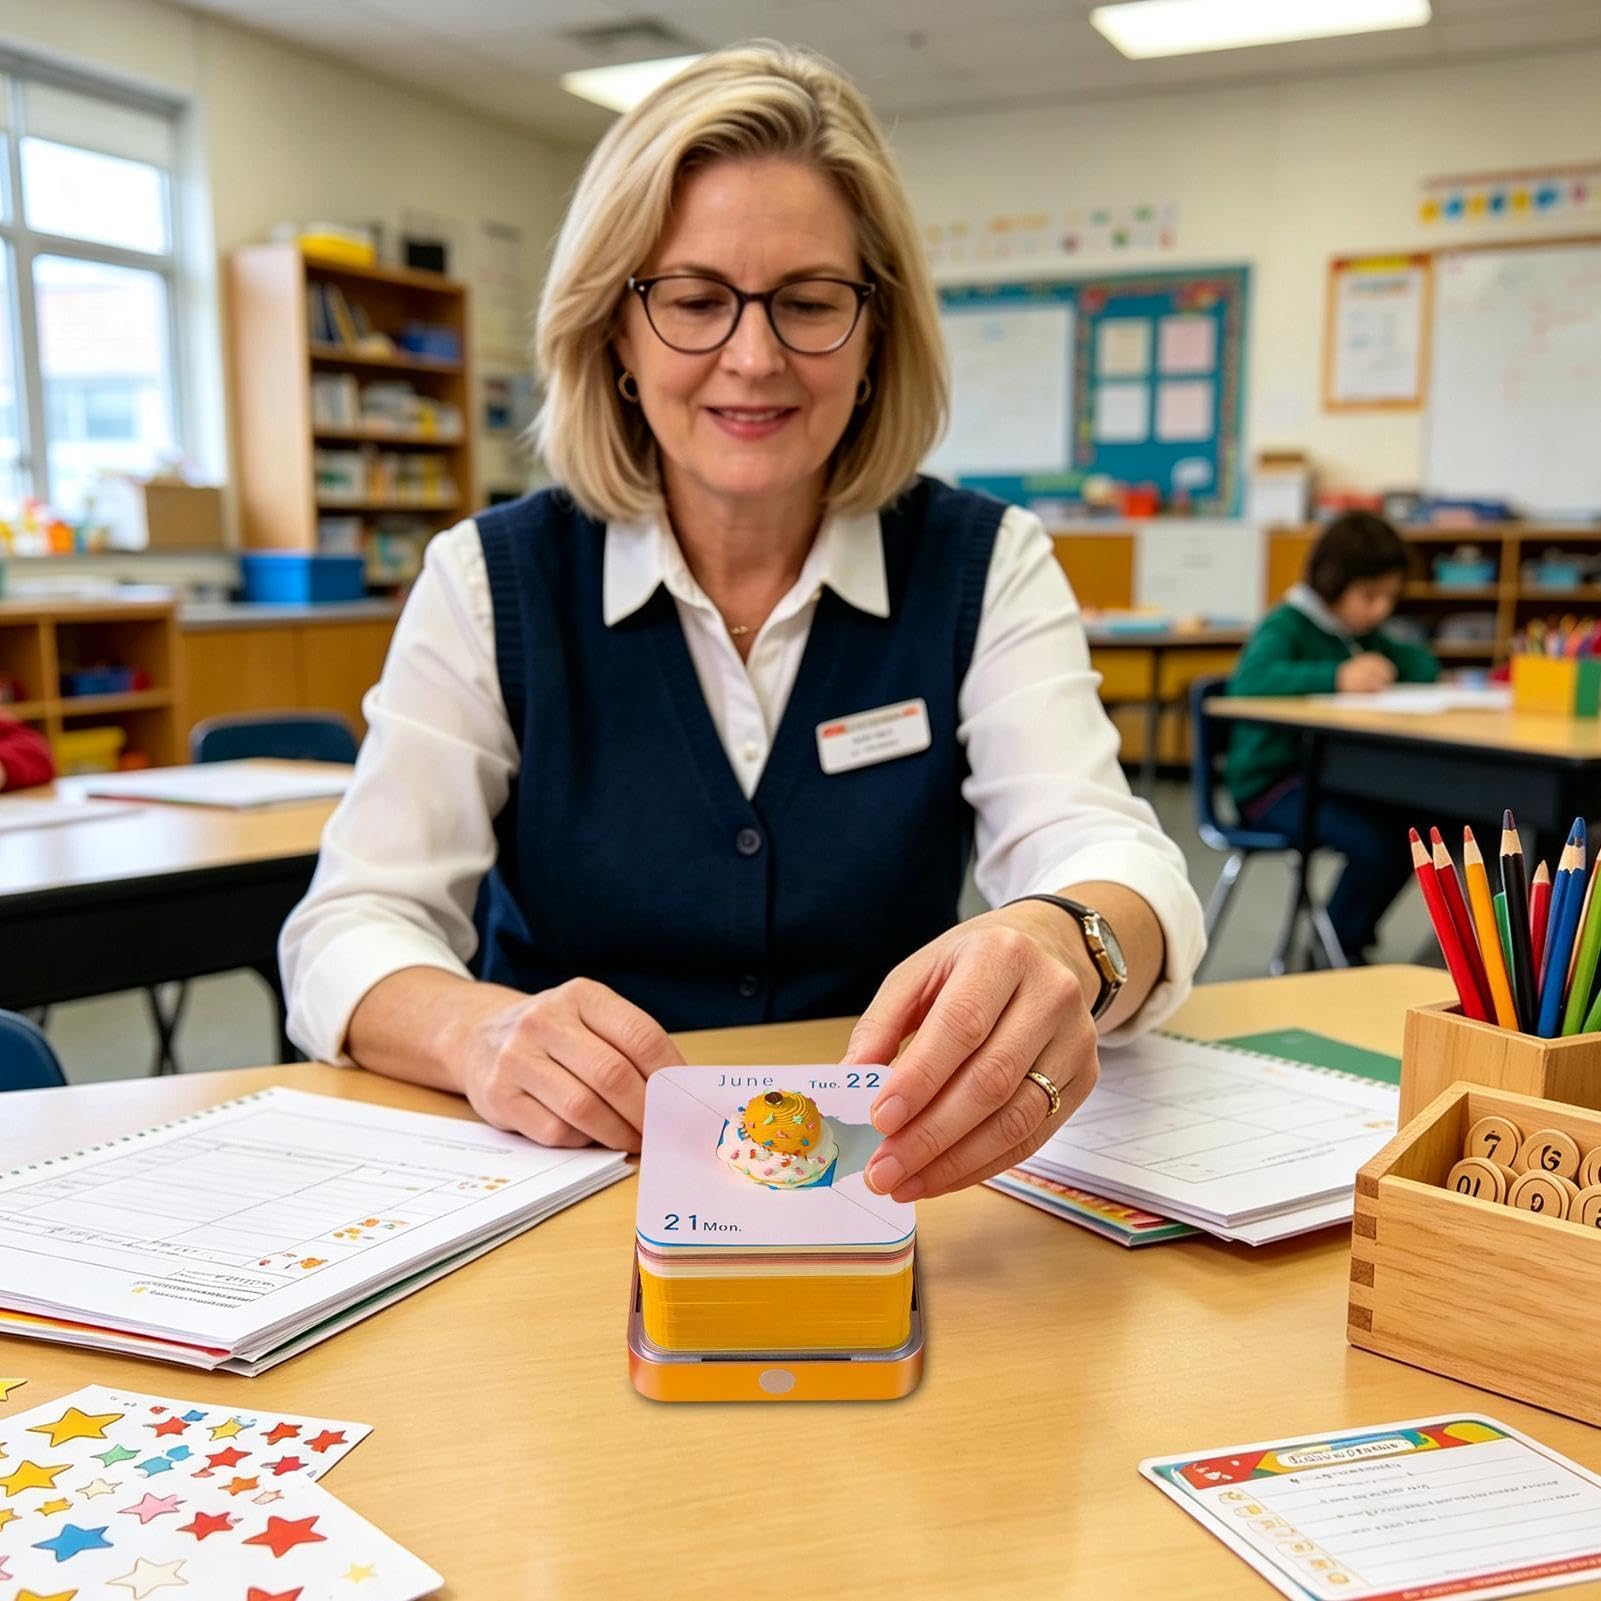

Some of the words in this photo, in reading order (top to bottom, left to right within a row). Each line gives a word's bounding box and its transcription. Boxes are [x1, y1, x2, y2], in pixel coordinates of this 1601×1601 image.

[717, 1074, 774, 1087] June
[808, 1079, 841, 1089] Tue.
[846, 1072, 880, 1089] 22
[663, 1213, 698, 1231] 21
[703, 1221, 742, 1232] Mon.
